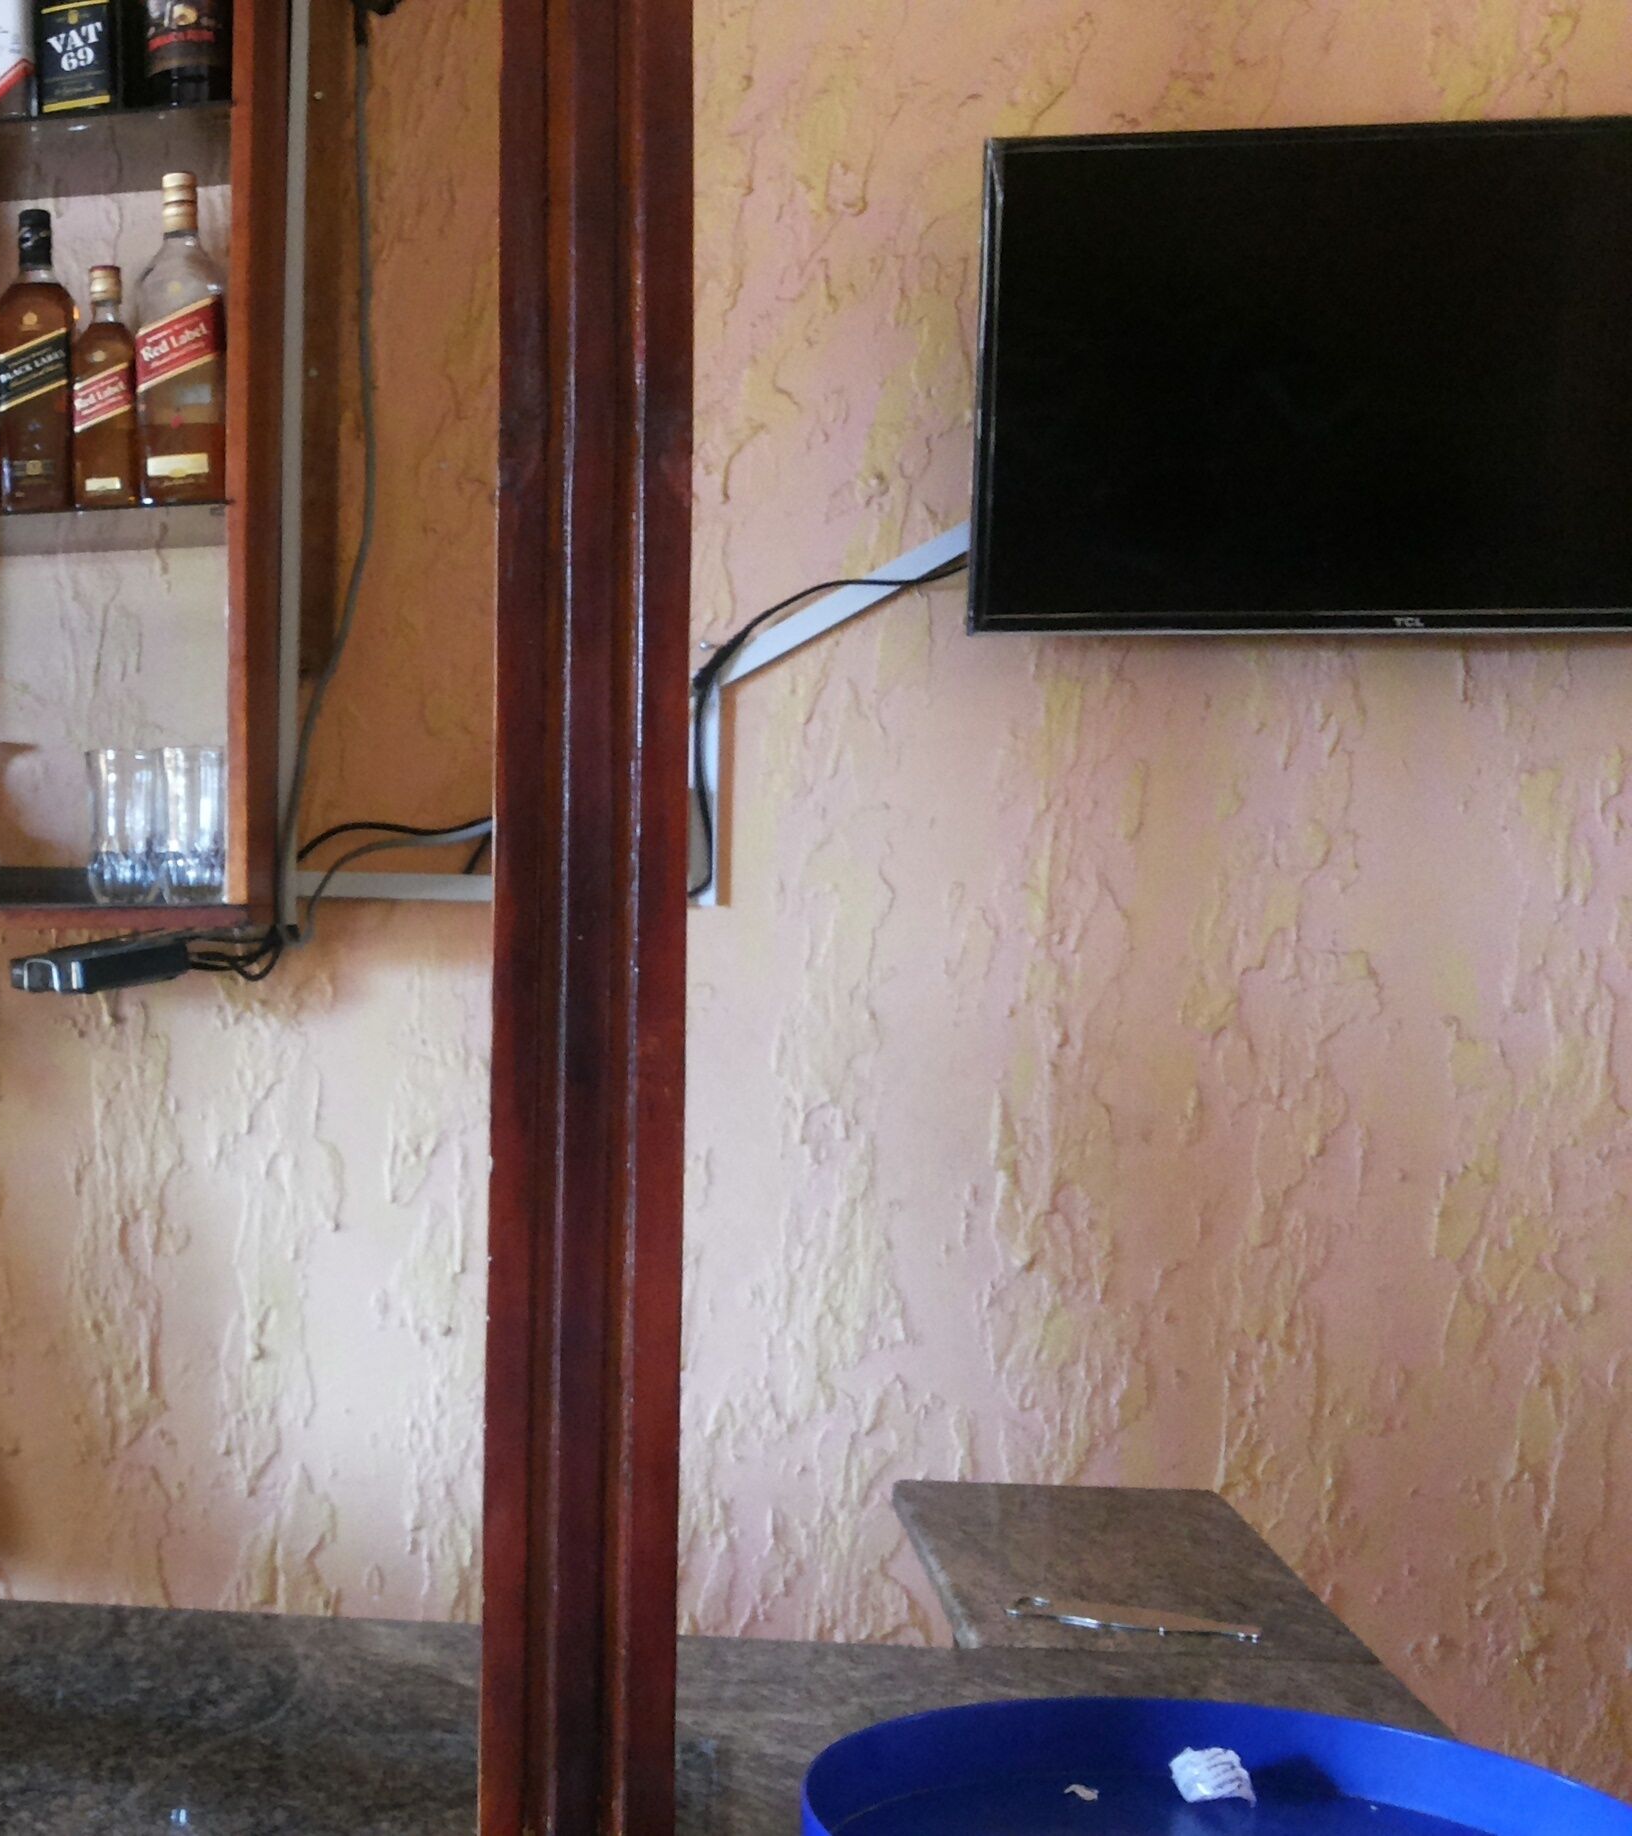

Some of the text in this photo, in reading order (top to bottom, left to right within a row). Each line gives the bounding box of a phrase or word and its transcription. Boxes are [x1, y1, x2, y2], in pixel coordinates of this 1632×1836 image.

[47, 22, 103, 53] VAT
[61, 47, 95, 71] 69
[140, 322, 208, 361] Red Label
[1393, 616, 1425, 627] TCL
